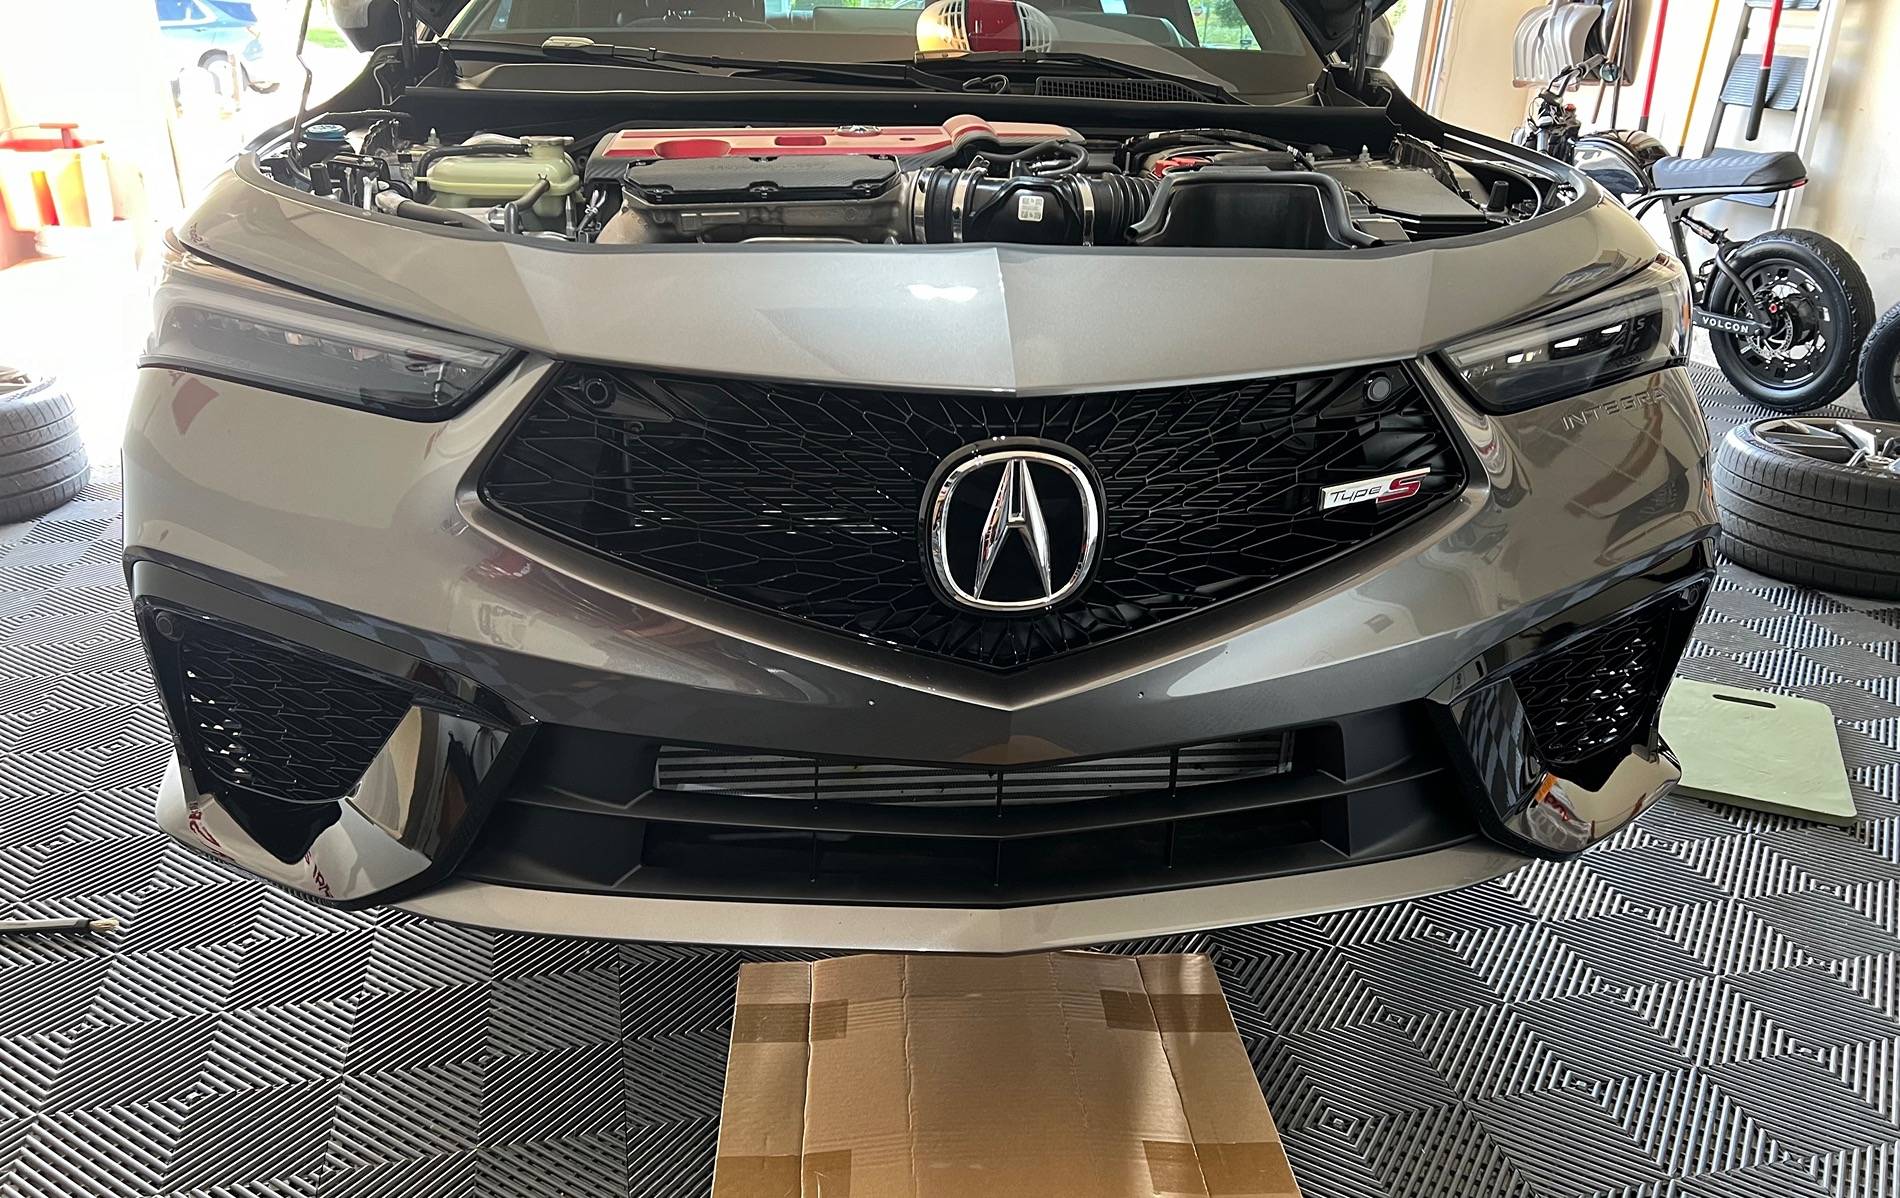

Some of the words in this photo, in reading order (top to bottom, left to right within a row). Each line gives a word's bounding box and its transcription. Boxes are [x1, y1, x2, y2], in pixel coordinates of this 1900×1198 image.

[1702, 316, 1749, 333] VOLCON
[1561, 387, 1671, 431] INTEGRA
[1330, 486, 1381, 503] Type
[1376, 473, 1427, 504] S
